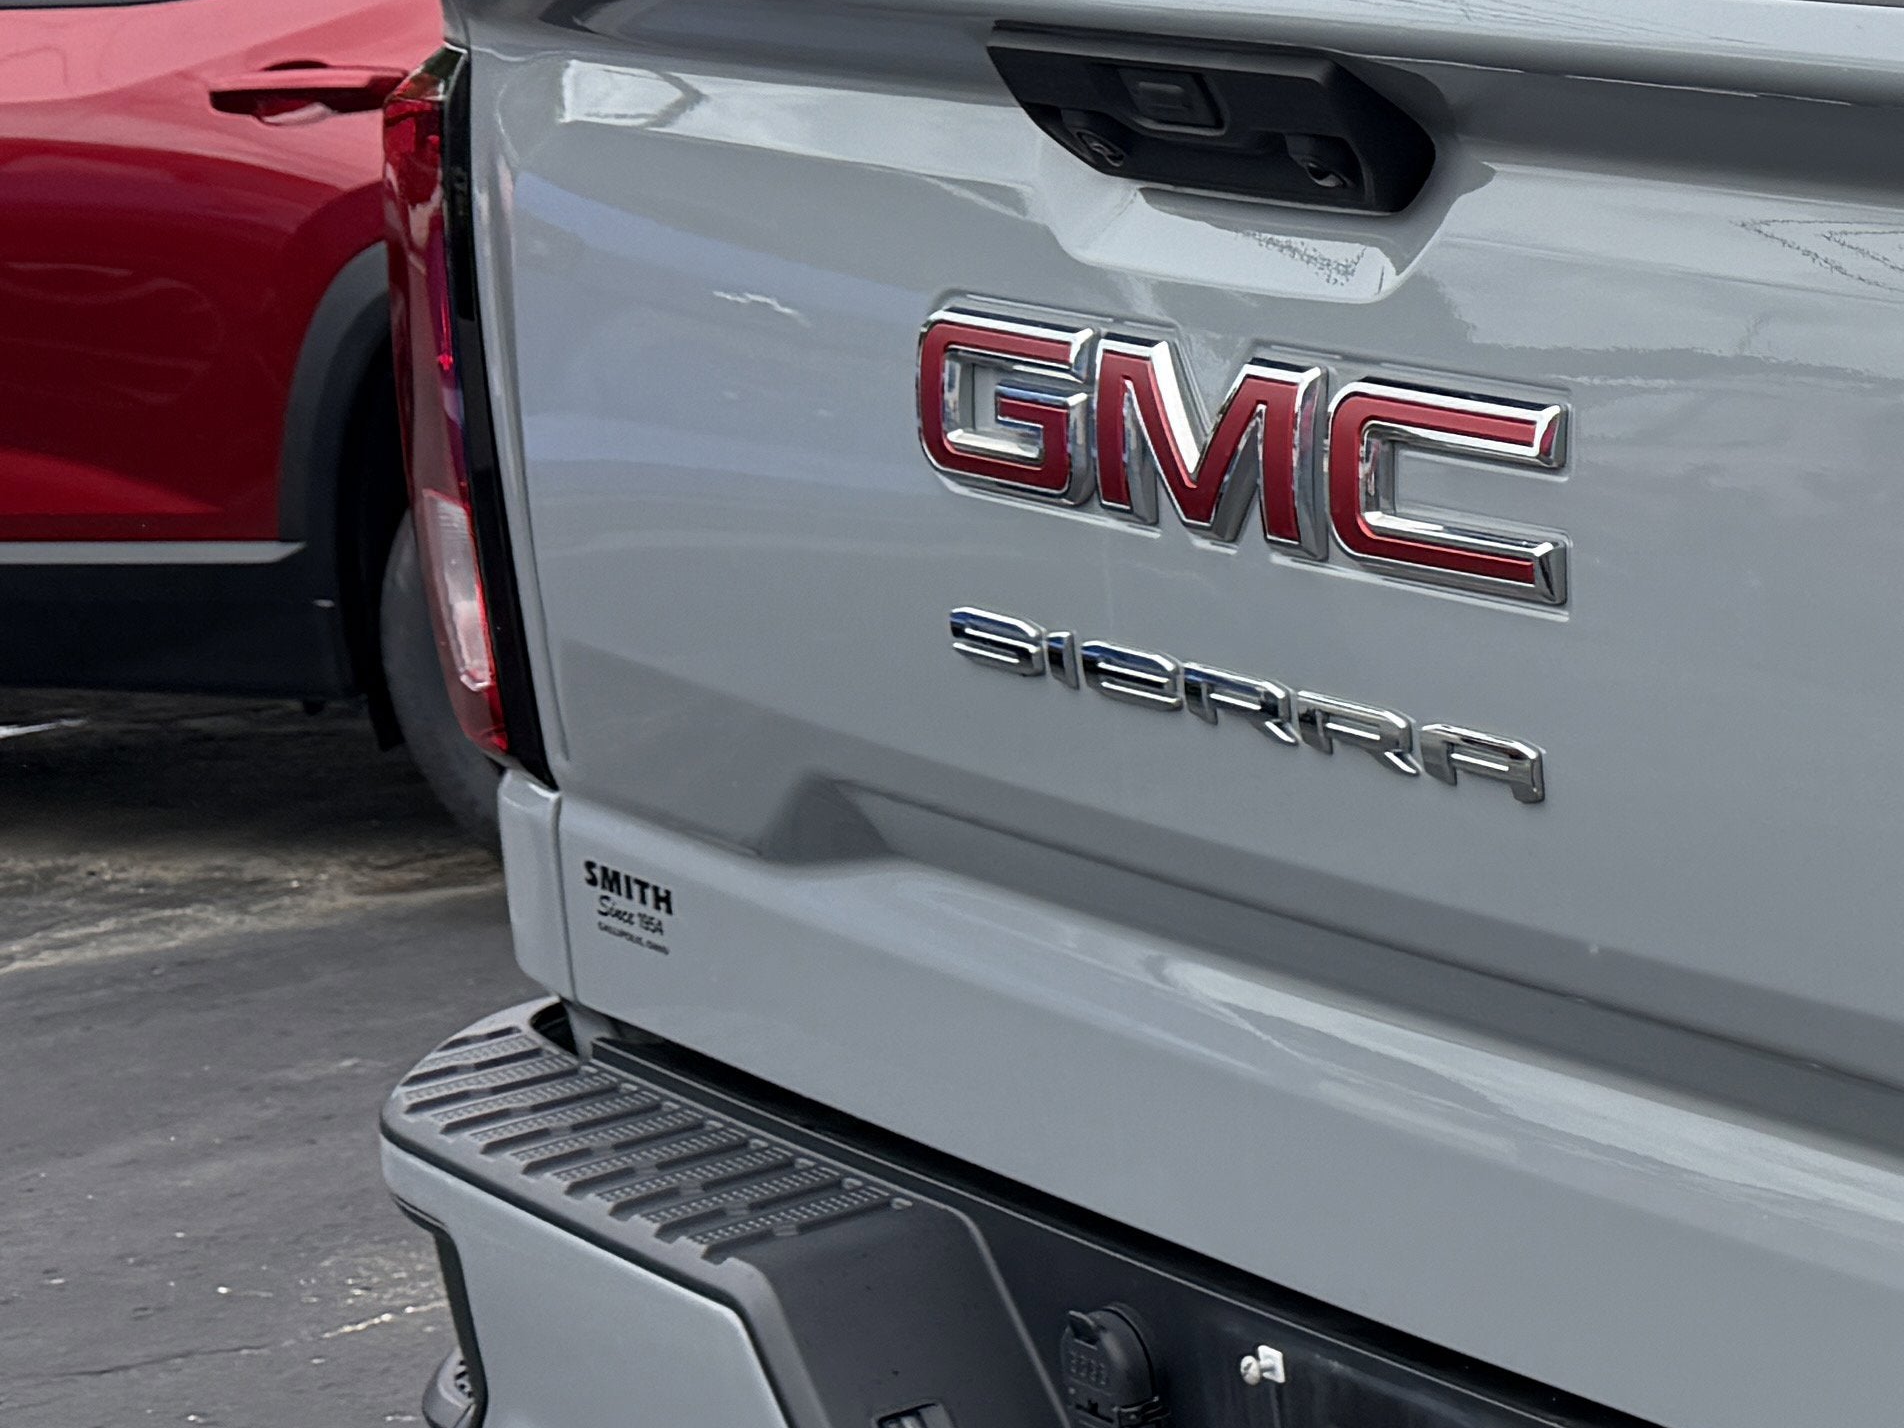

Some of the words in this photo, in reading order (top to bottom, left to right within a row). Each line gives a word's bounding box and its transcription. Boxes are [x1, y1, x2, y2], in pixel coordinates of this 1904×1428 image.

[917, 304, 1573, 610] GMC
[948, 605, 1546, 805] SIERRA
[585, 860, 673, 915] SMITH
[598, 895, 635, 925] Since
